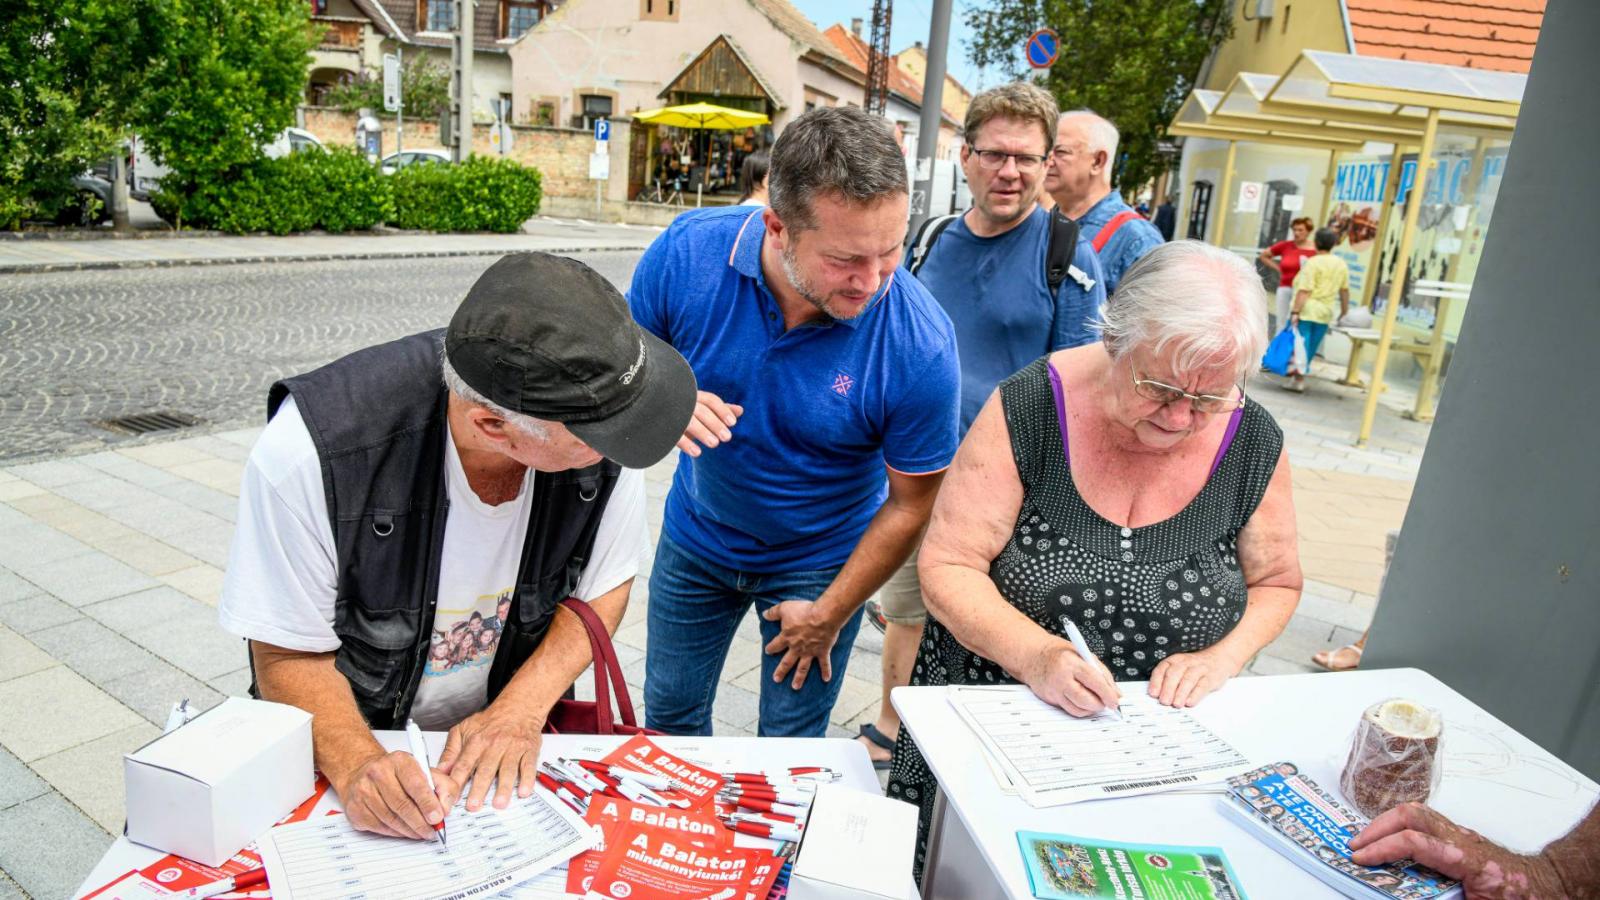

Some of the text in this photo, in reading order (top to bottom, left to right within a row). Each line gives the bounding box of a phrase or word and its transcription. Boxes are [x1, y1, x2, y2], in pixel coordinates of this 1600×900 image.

[598, 122, 606, 139] P
[634, 745, 718, 789] A Balaton
[1262, 785, 1276, 795] A
[1275, 793, 1294, 809] TE
[1271, 782, 1285, 792] A
[1286, 789, 1303, 805] TE
[601, 802, 716, 836] A Balaton
[626, 848, 742, 884] mindannyiunké!
[631, 833, 648, 850] A
[659, 841, 747, 871] Balaton
